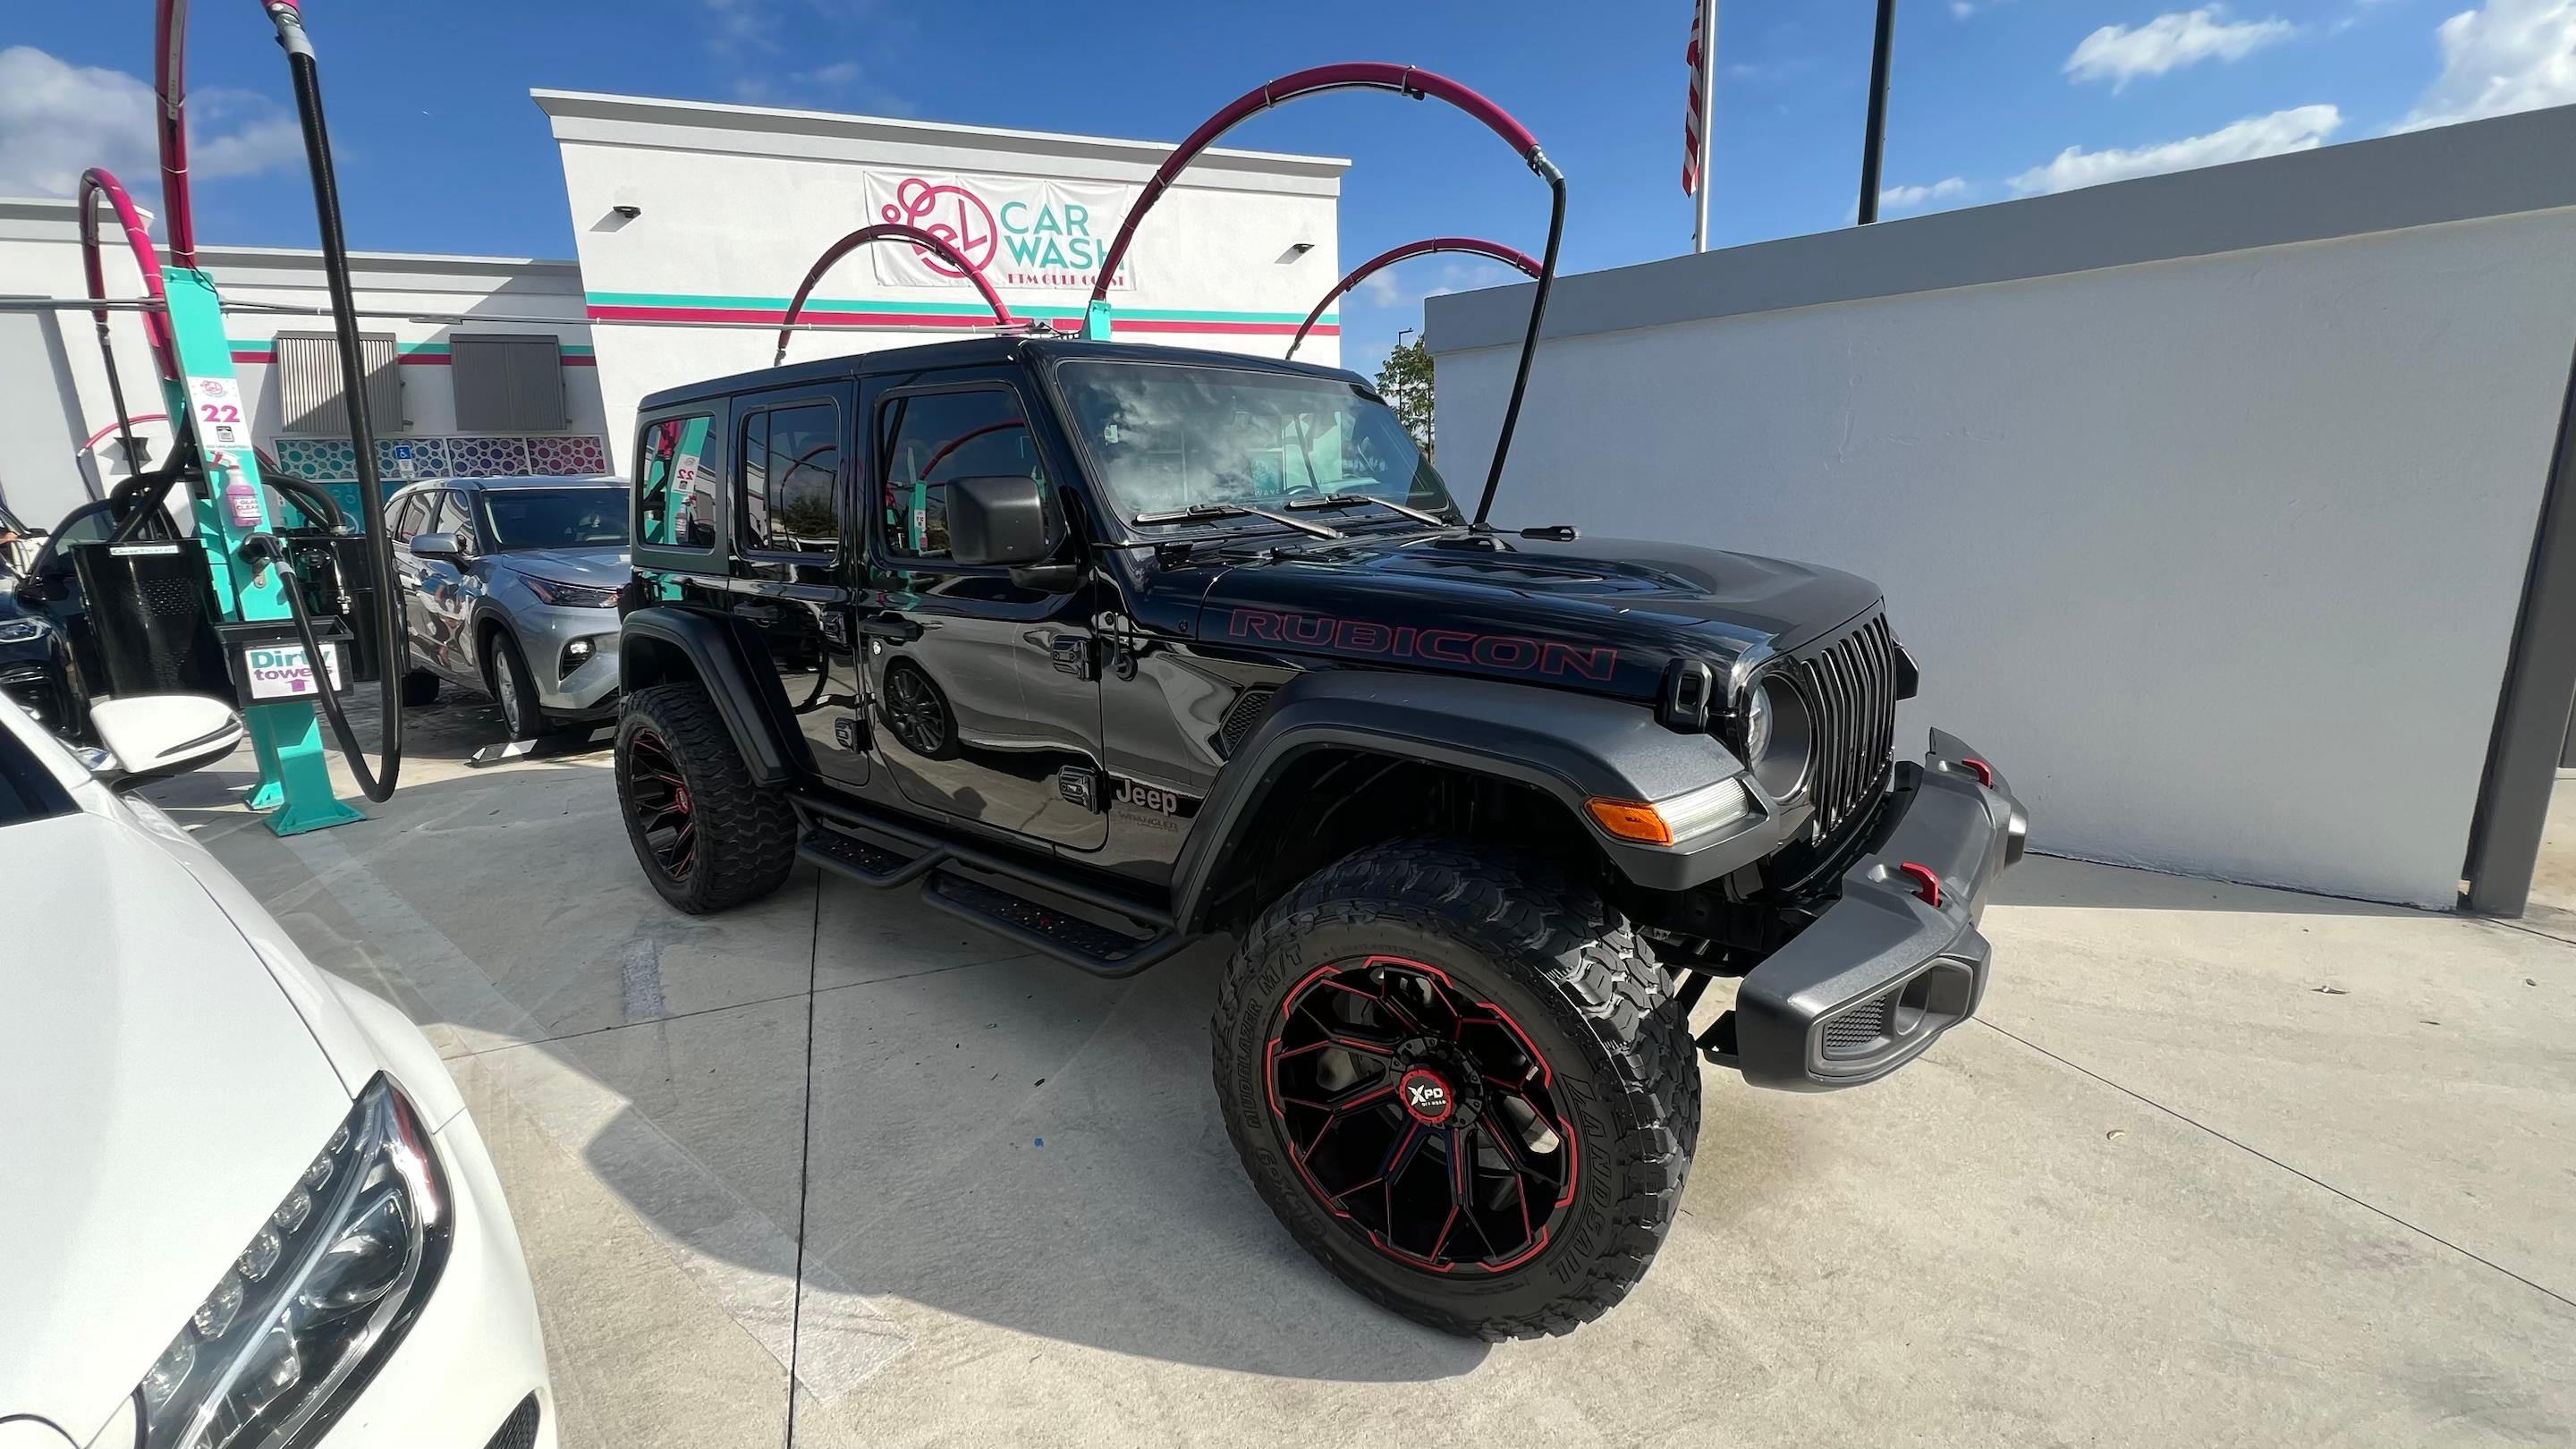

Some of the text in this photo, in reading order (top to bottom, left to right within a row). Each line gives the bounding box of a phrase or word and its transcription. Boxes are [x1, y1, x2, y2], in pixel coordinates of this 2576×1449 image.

[1000, 201, 1090, 236] CAR
[1004, 235, 1124, 271] WASH
[200, 404, 241, 423] 22
[1229, 608, 1618, 682] RUBICON
[254, 665, 333, 681] towes
[1115, 778, 1177, 817] Jeep
[1117, 810, 1179, 830] WRANGLER
[1236, 944, 1302, 1130] MUDBLAZER M/T
[1407, 1084, 1444, 1106] XPD
[1549, 1072, 1612, 1284] LANDSAIL
